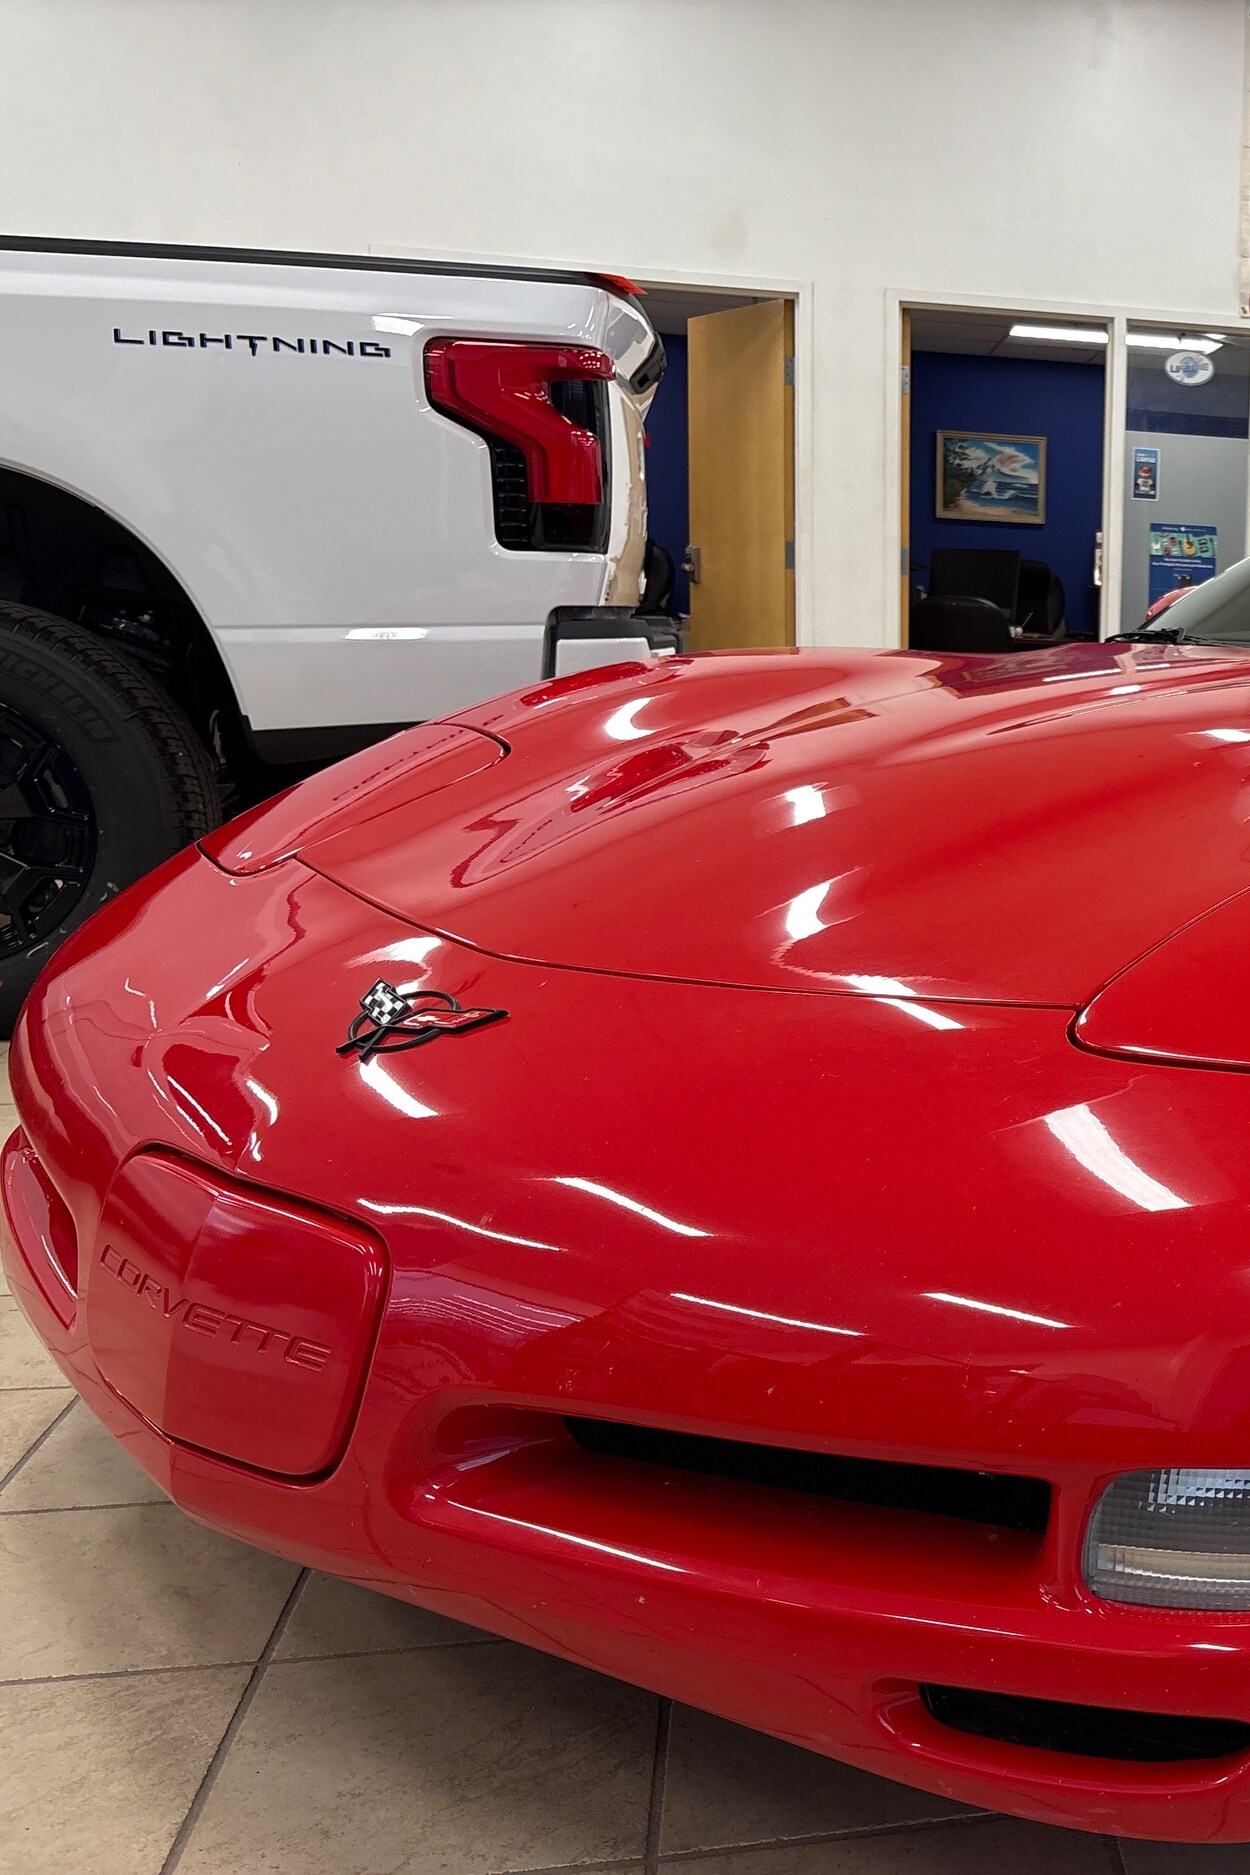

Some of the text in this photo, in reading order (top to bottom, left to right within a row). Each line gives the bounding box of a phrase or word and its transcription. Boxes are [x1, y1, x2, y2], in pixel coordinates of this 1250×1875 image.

[113, 328, 391, 357] LIGHTNING
[0, 647, 120, 743] ICHELIN
[100, 1244, 334, 1372] CORVETTE
